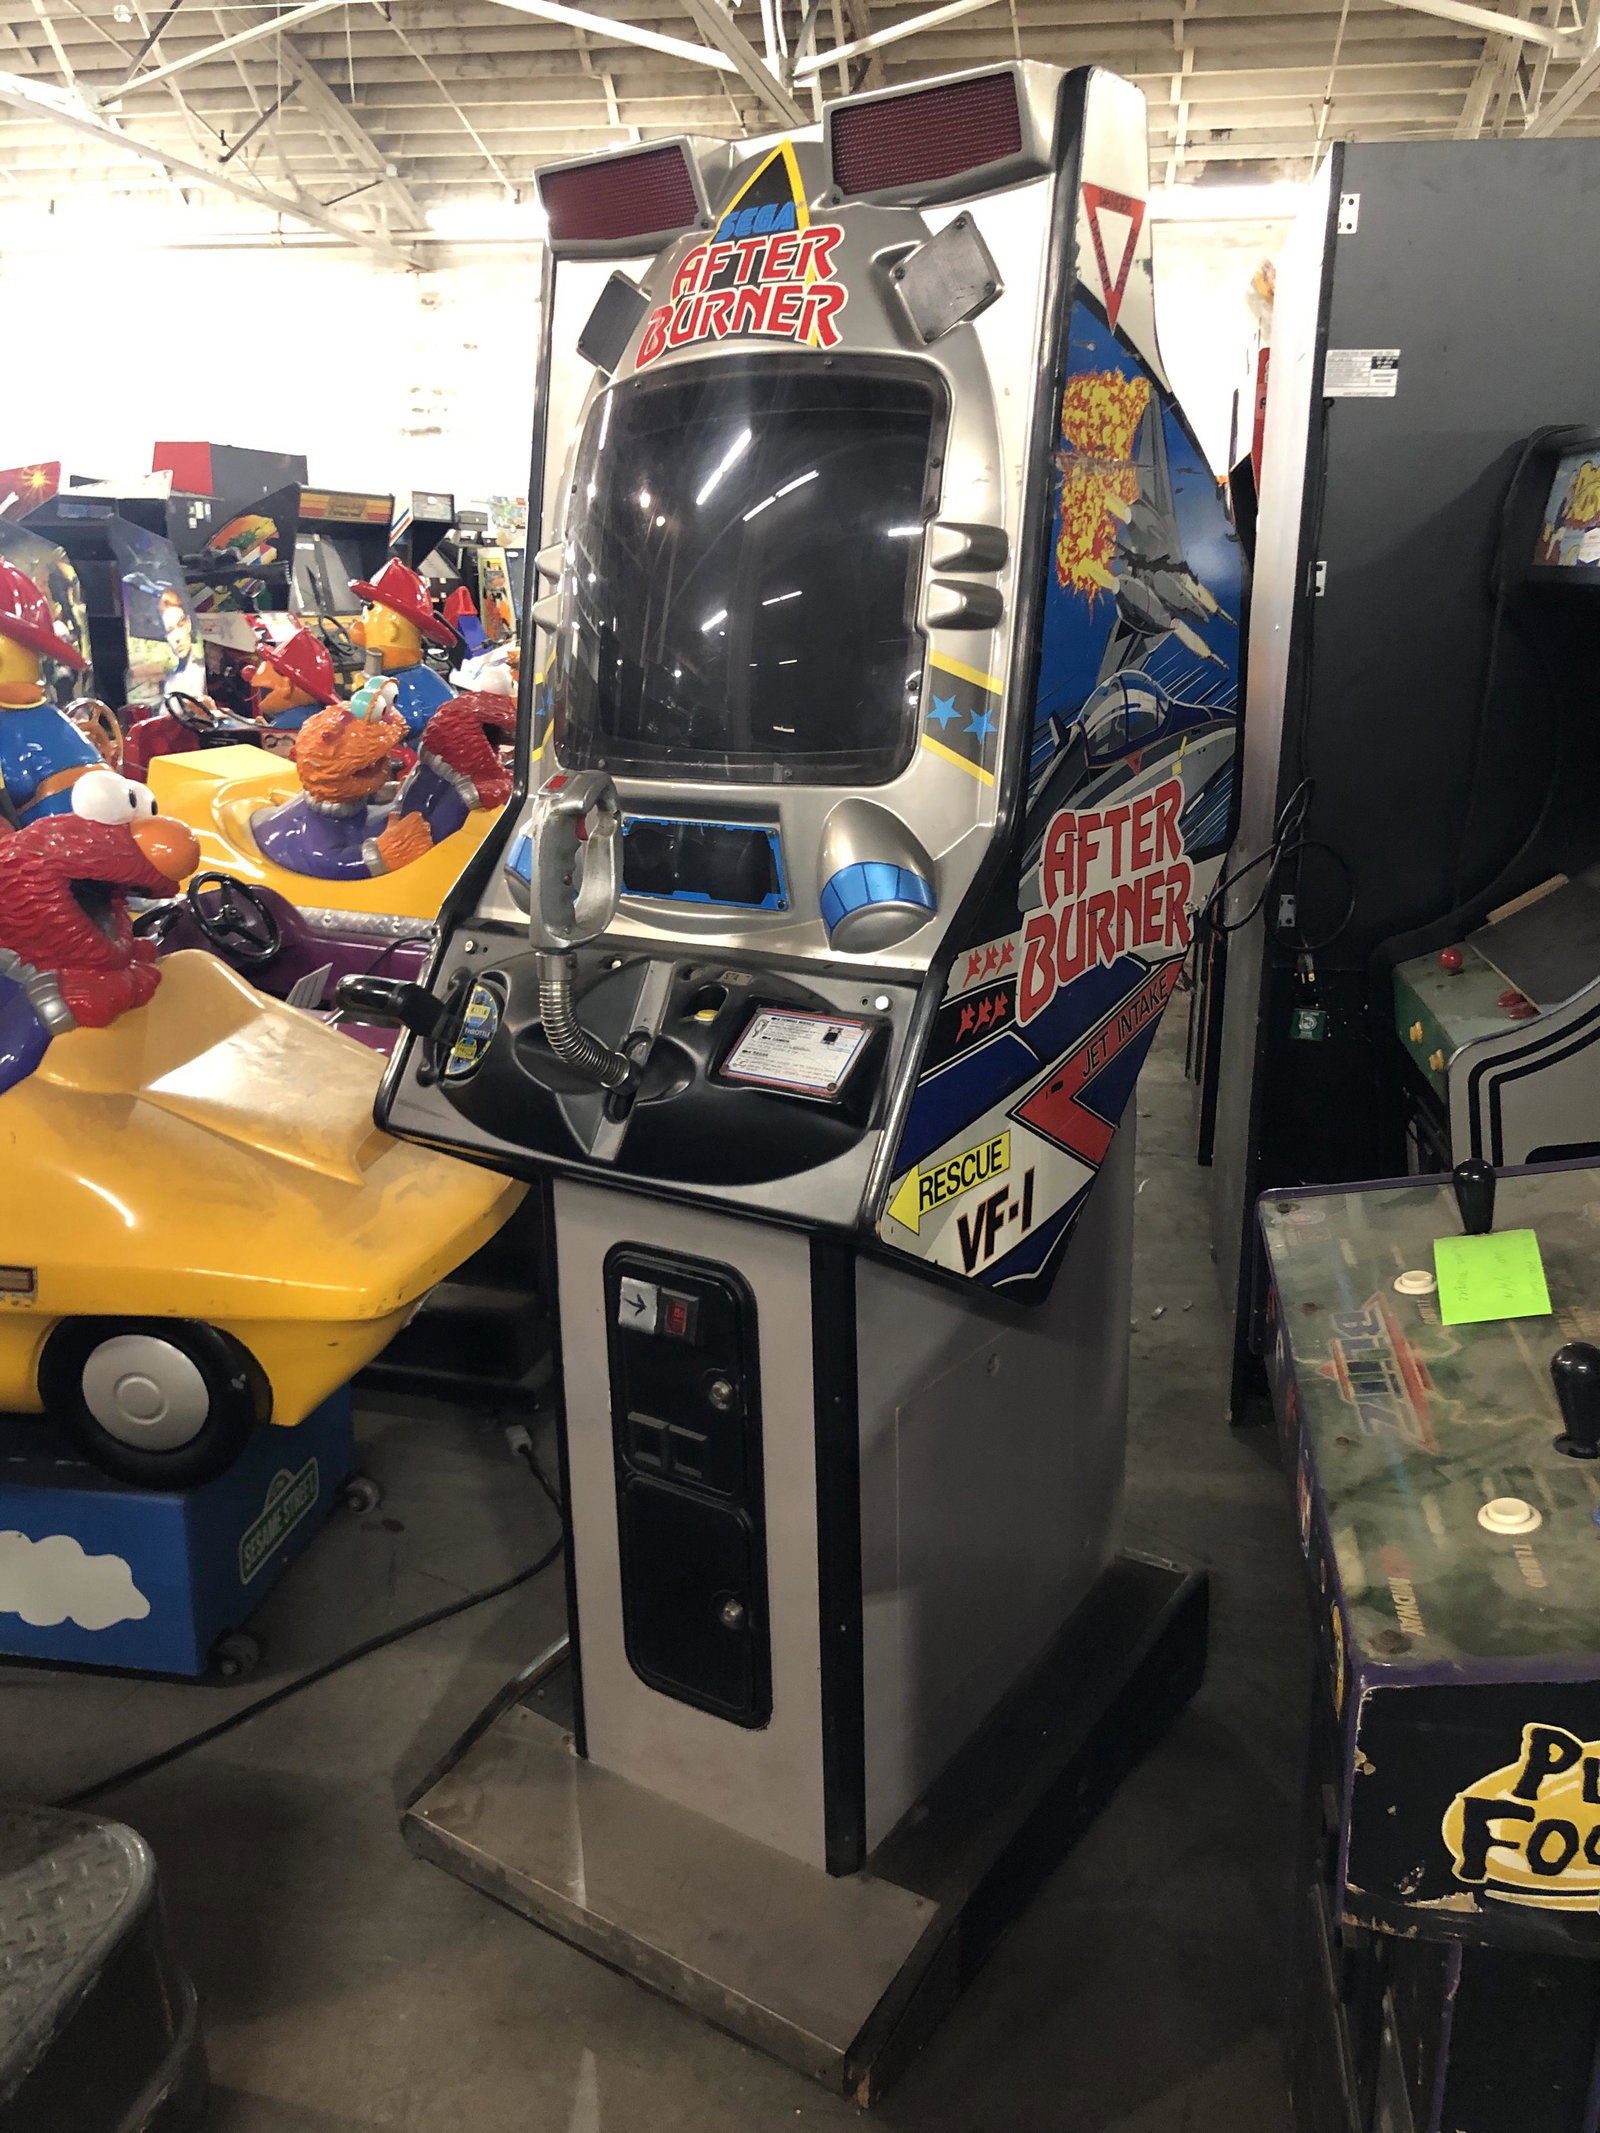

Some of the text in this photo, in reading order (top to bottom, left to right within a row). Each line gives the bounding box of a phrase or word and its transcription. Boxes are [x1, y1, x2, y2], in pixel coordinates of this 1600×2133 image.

[714, 201, 796, 242] SEGA
[671, 225, 844, 302] AFTER
[635, 284, 847, 371] BURNER
[1043, 779, 1183, 909] AFTER
[1019, 861, 1191, 1023] BURNER
[1082, 974, 1168, 1077] JET INTAKE
[919, 1141, 1002, 1212] RESCUE
[1512, 1544, 1547, 1587] TURBO
[1388, 1576, 1426, 1637] MIDWAY
